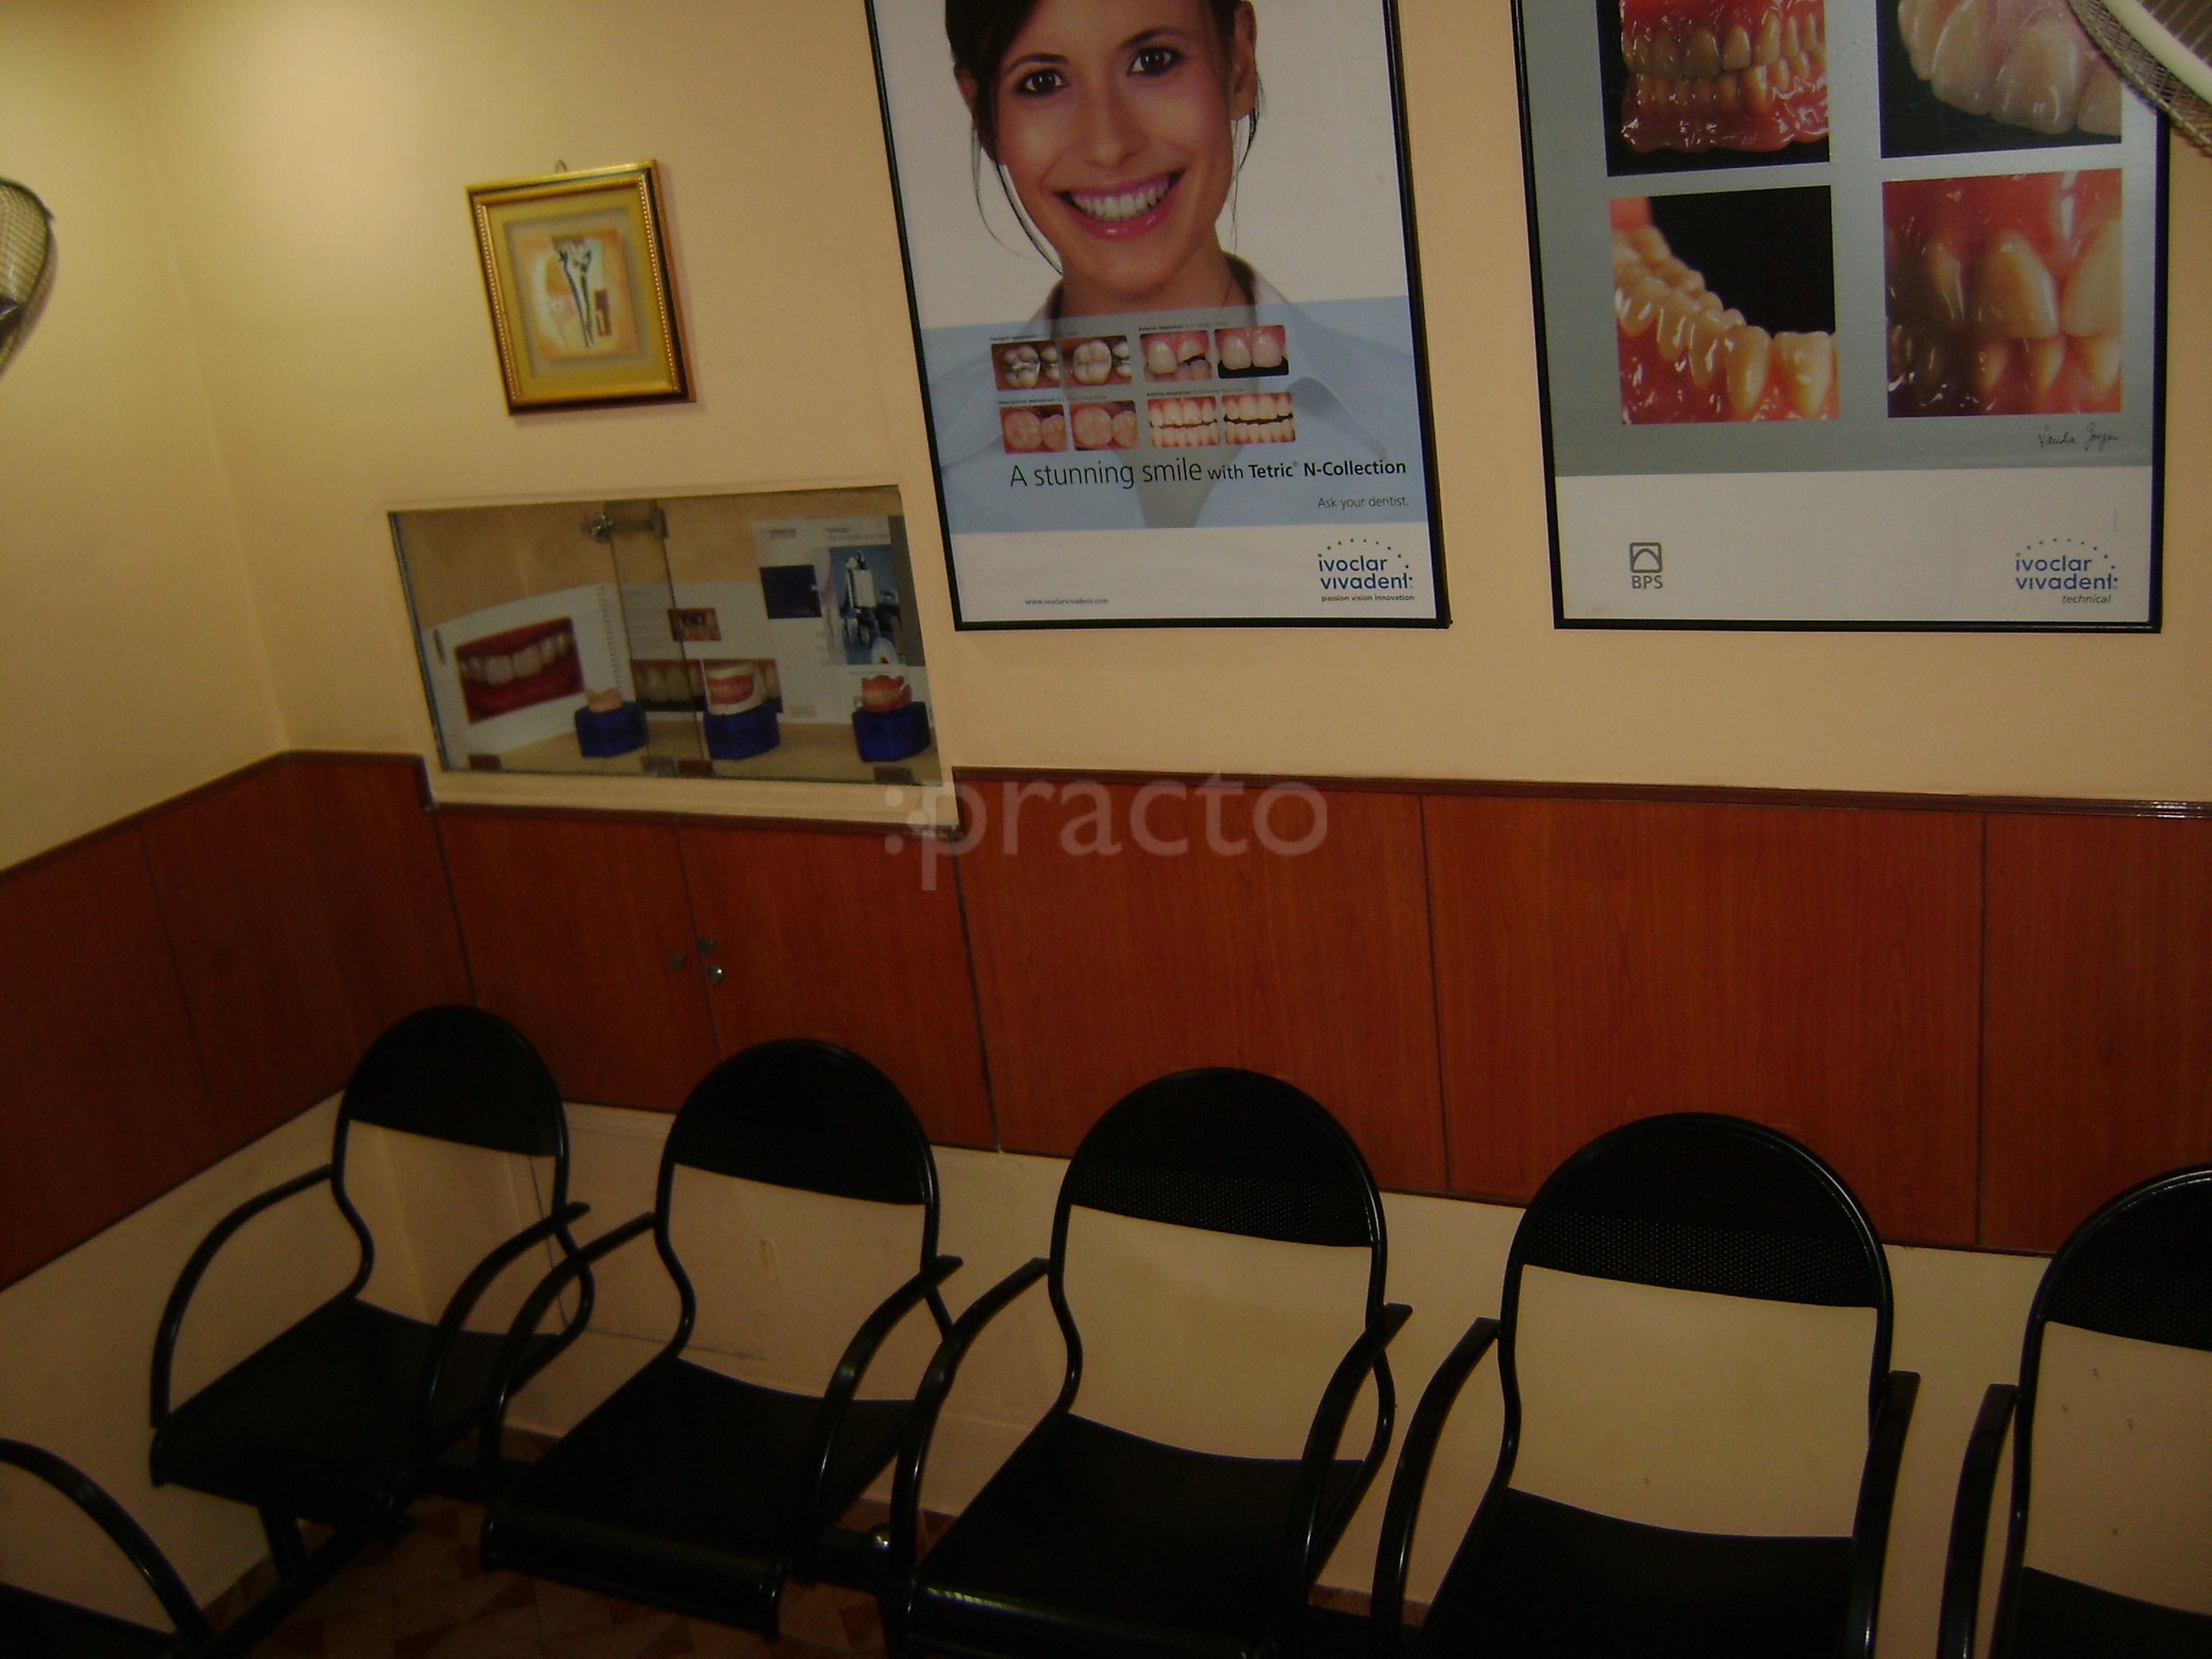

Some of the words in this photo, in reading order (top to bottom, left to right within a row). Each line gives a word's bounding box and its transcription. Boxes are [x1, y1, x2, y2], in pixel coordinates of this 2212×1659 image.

[1010, 464, 1028, 487] A
[1034, 461, 1134, 490] stunning
[1143, 457, 1202, 482] smile
[1208, 464, 1244, 480] with
[1304, 459, 1407, 477] N-Collection
[1318, 496, 1338, 508] Ask
[1341, 498, 1365, 511] your
[1368, 494, 1409, 508] dentist.
[1318, 554, 1388, 572] ivoclar
[2015, 554, 2092, 572] ivoclar
[1320, 572, 1408, 590] vivadent
[1632, 575, 1663, 589] BPS
[2015, 572, 2112, 590] vivadent
[1321, 594, 1350, 603] passion
[2062, 594, 2112, 604] technical
